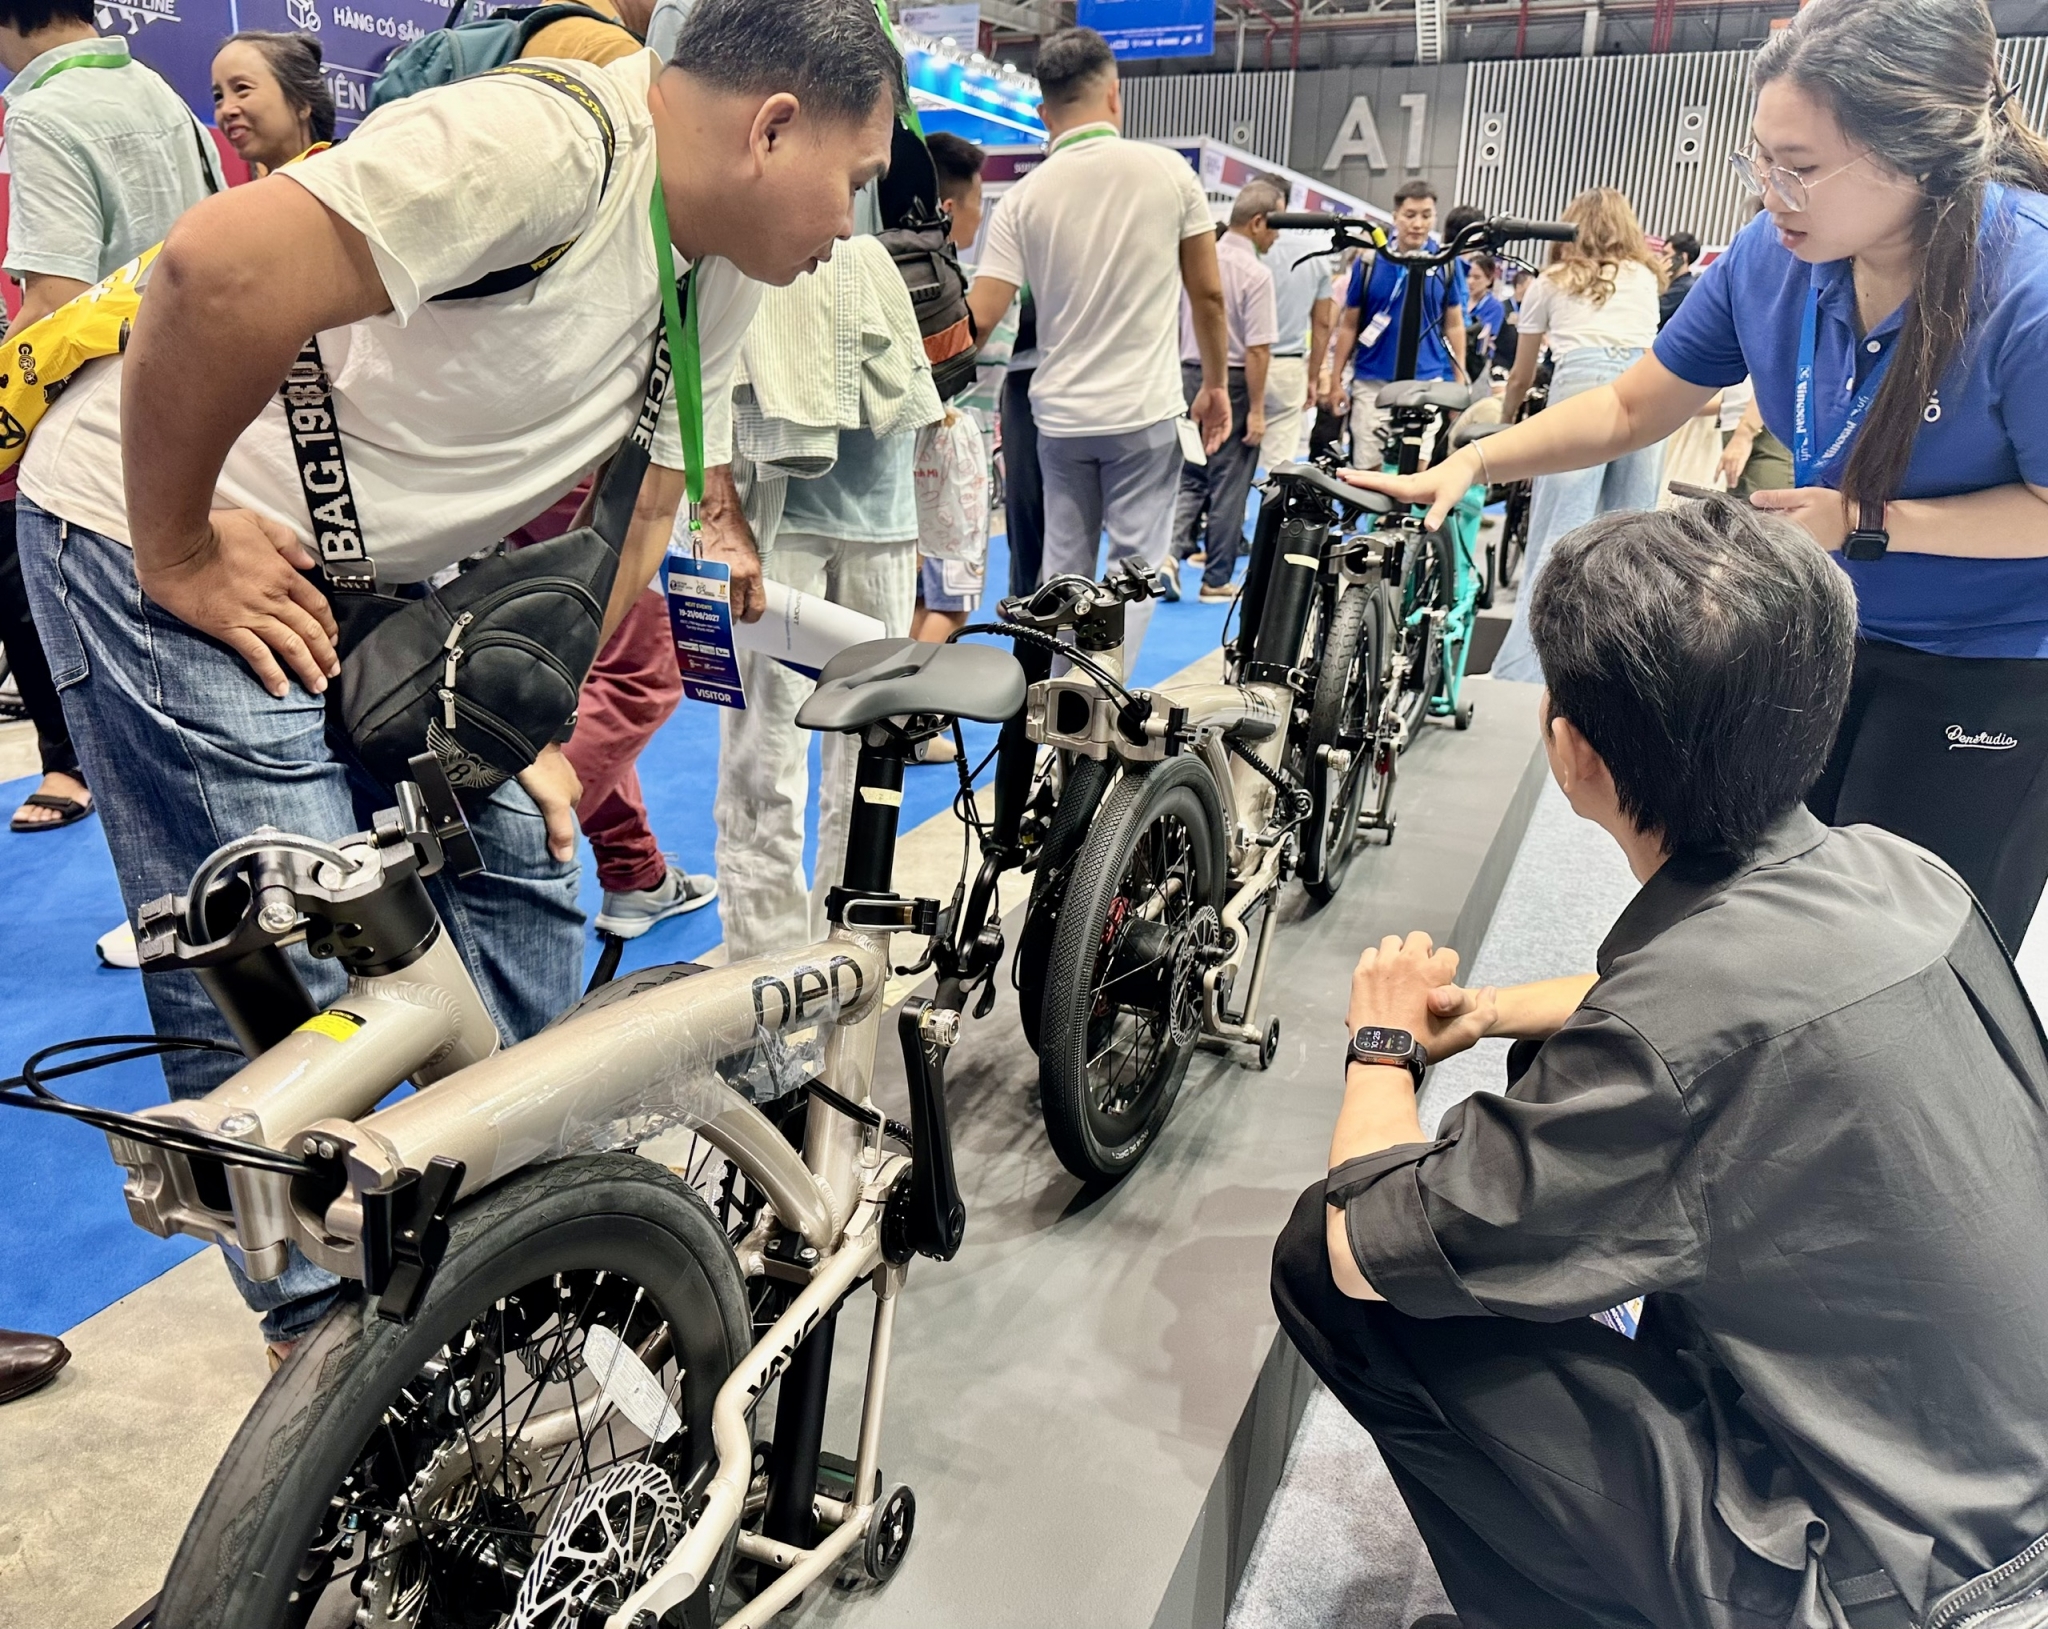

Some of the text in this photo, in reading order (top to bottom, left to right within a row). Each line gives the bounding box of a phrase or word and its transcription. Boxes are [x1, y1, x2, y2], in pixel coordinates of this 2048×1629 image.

[333, 6, 375, 33] HÀNG
[376, 17, 396, 38] CÓ
[326, 73, 367, 112] IÊN
[1322, 93, 1427, 170] A1
[631, 326, 673, 450] UCHE
[695, 687, 732, 703] VISITOR
[1371, 1030, 1381, 1049] 10:25
